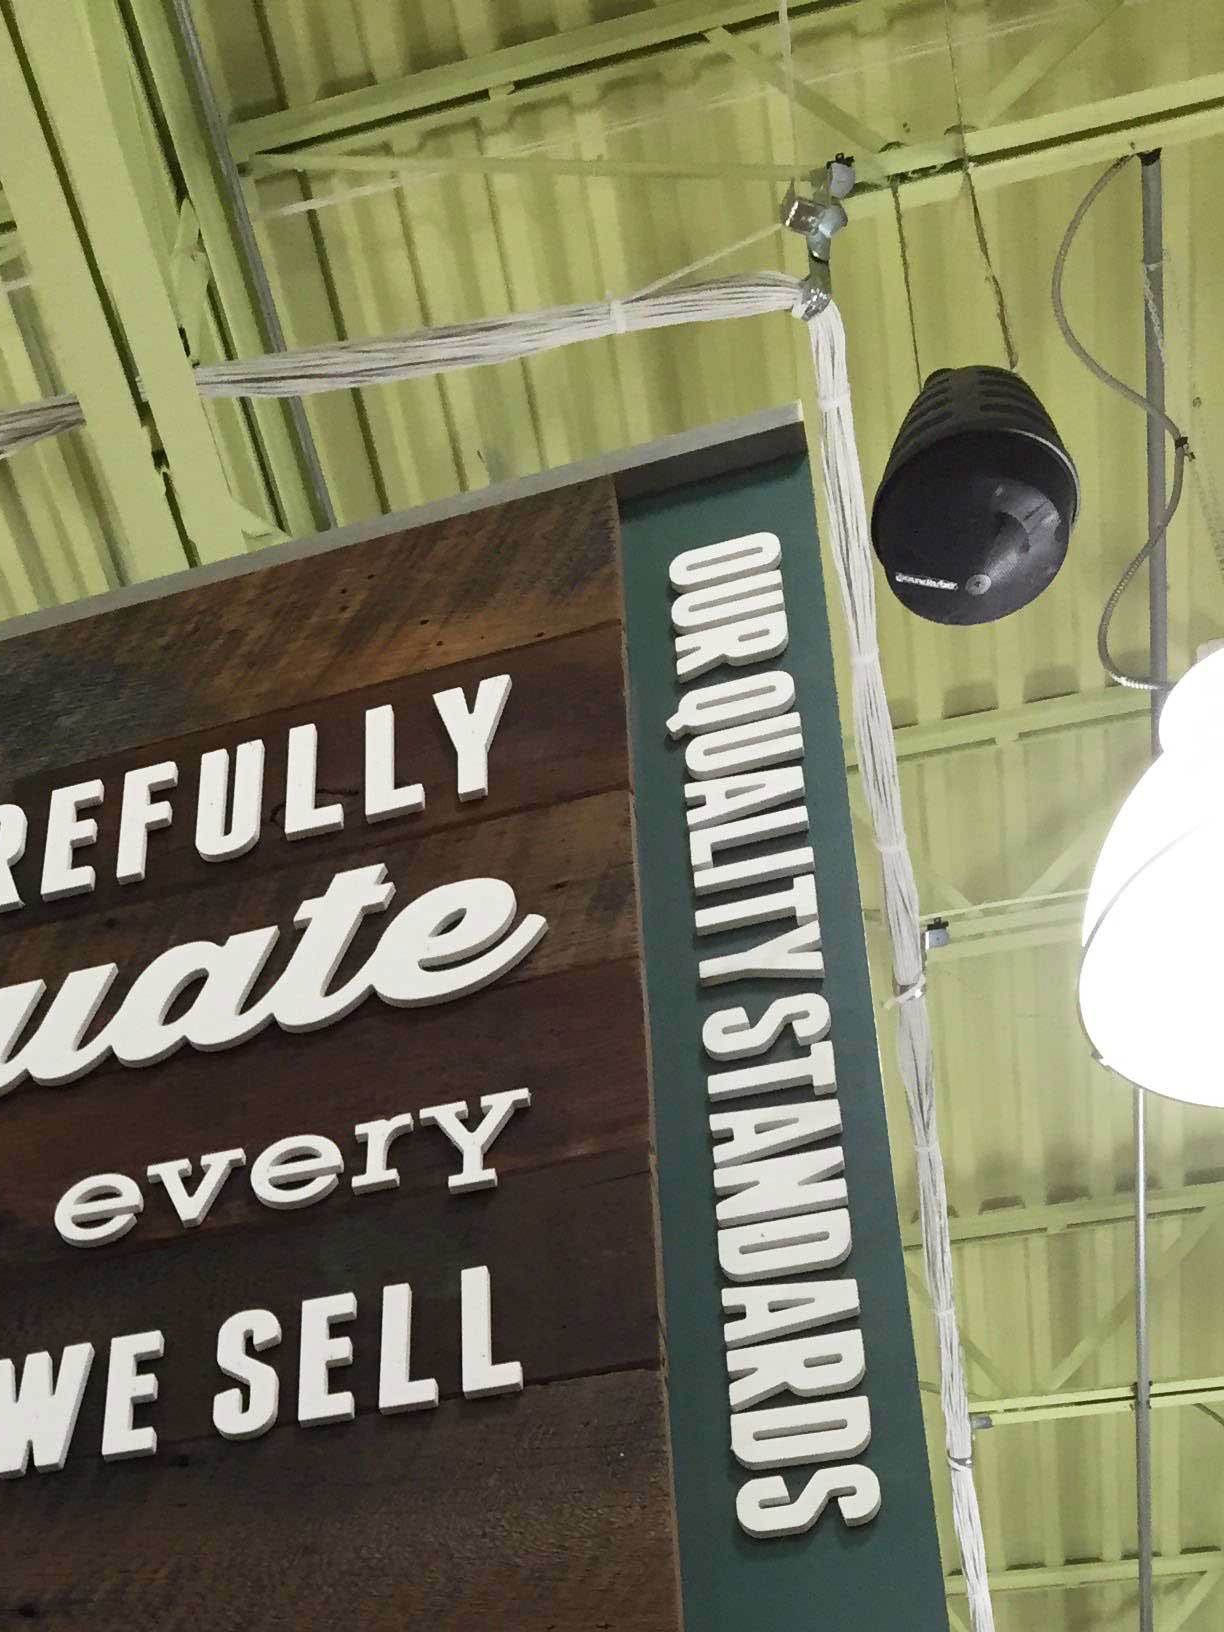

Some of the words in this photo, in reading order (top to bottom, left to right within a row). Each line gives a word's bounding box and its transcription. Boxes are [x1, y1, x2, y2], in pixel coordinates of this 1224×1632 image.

[669, 532, 789, 683] OUR
[665, 670, 825, 988] QUALITY
[53, 1087, 531, 1249] every
[212, 1264, 523, 1440] SELL
[702, 992, 881, 1539] STANDARDS
